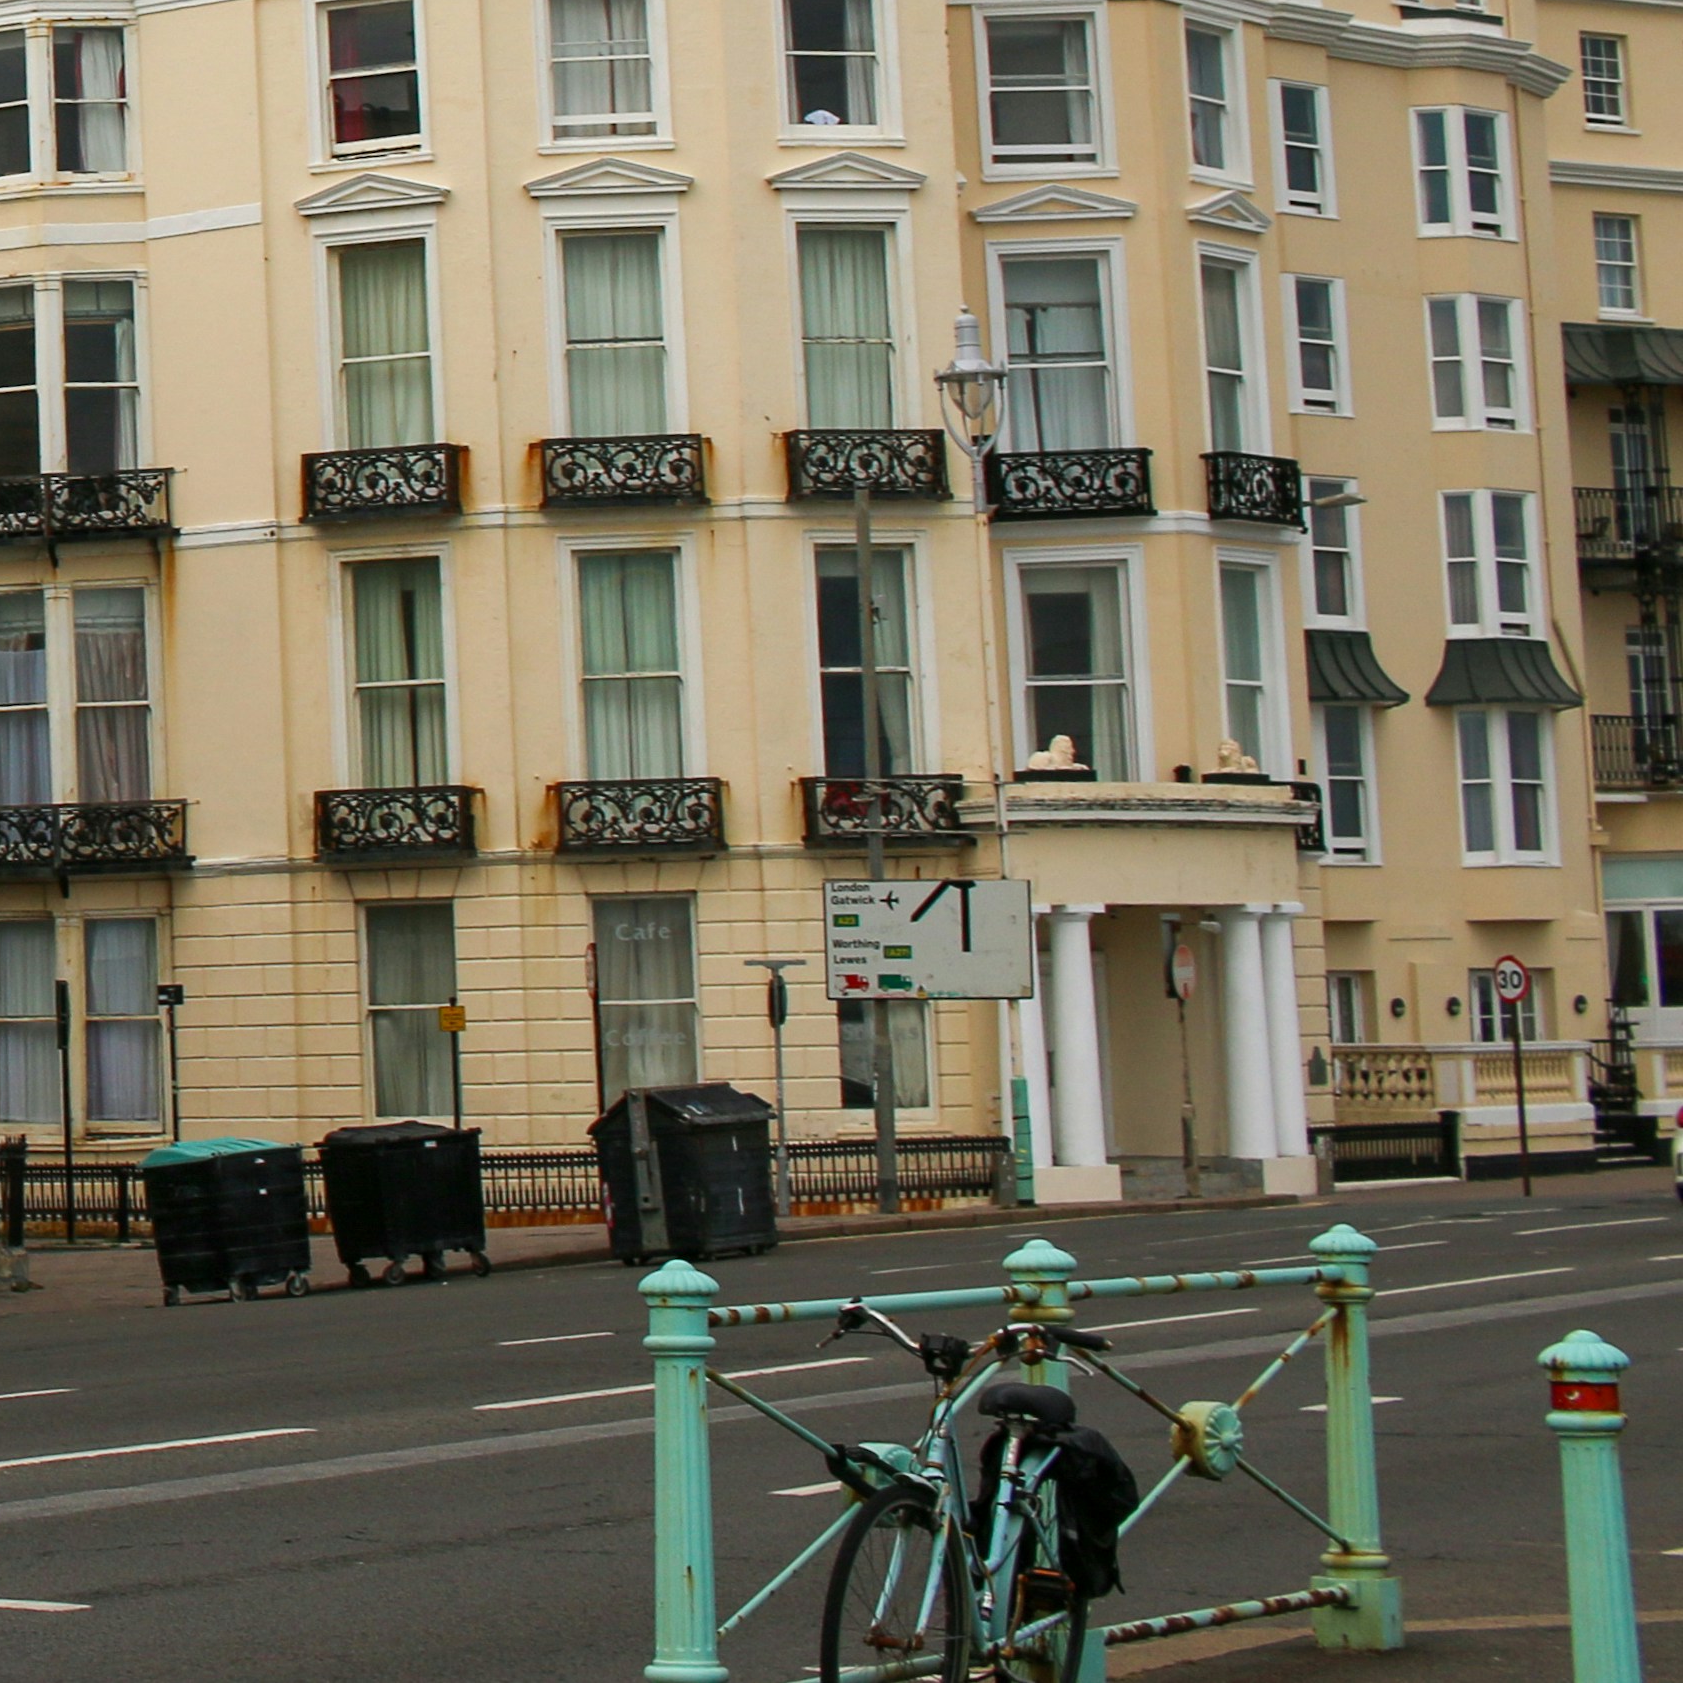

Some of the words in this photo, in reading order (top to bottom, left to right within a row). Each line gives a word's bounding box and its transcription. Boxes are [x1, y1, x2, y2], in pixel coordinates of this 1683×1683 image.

[831, 882, 870, 892] London
[831, 895, 875, 905] Gatwick
[614, 923, 672, 941] Cafe
[832, 939, 880, 950] Worthing
[833, 955, 867, 964] Lewes
[1498, 970, 1522, 989] 30
[604, 1026, 686, 1047] Coffee
